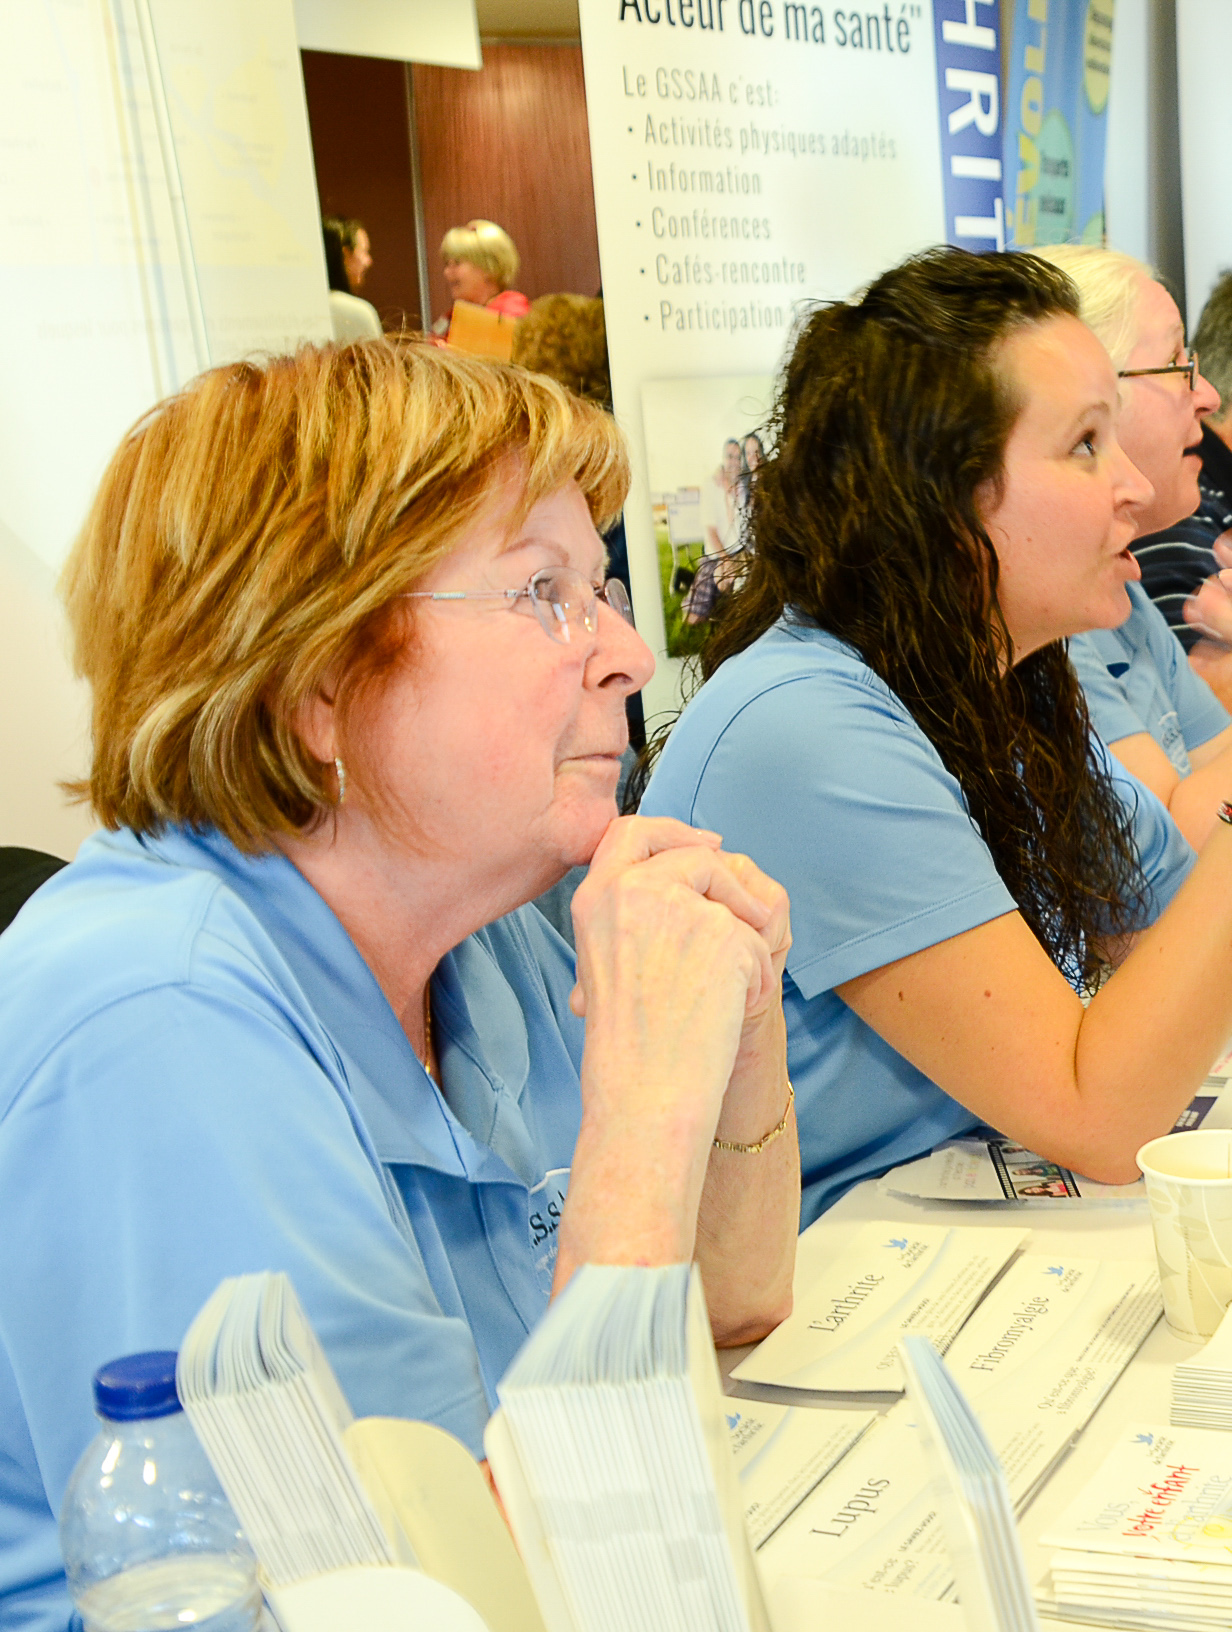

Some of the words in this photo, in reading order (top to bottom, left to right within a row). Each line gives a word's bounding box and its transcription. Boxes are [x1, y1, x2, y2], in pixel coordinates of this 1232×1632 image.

[618, 0, 727, 33] Acteur
[738, 0, 774, 37] de
[785, 6, 826, 45] ma
[622, 65, 646, 98] Le
[656, 67, 721, 102] GSSAA
[644, 114, 733, 150] Activités
[739, 125, 826, 160] physiques
[831, 128, 897, 161] adaptés
[647, 161, 762, 195] Information
[651, 207, 771, 240] Conférences
[656, 255, 806, 285] Cafés-rencontre
[659, 300, 783, 331] Participation
[808, 1274, 885, 1332] L'arthrite
[969, 1296, 1050, 1372] Fibromyalgie
[1150, 1464, 1200, 1507] enfant
[809, 1477, 890, 1538] Lupus
